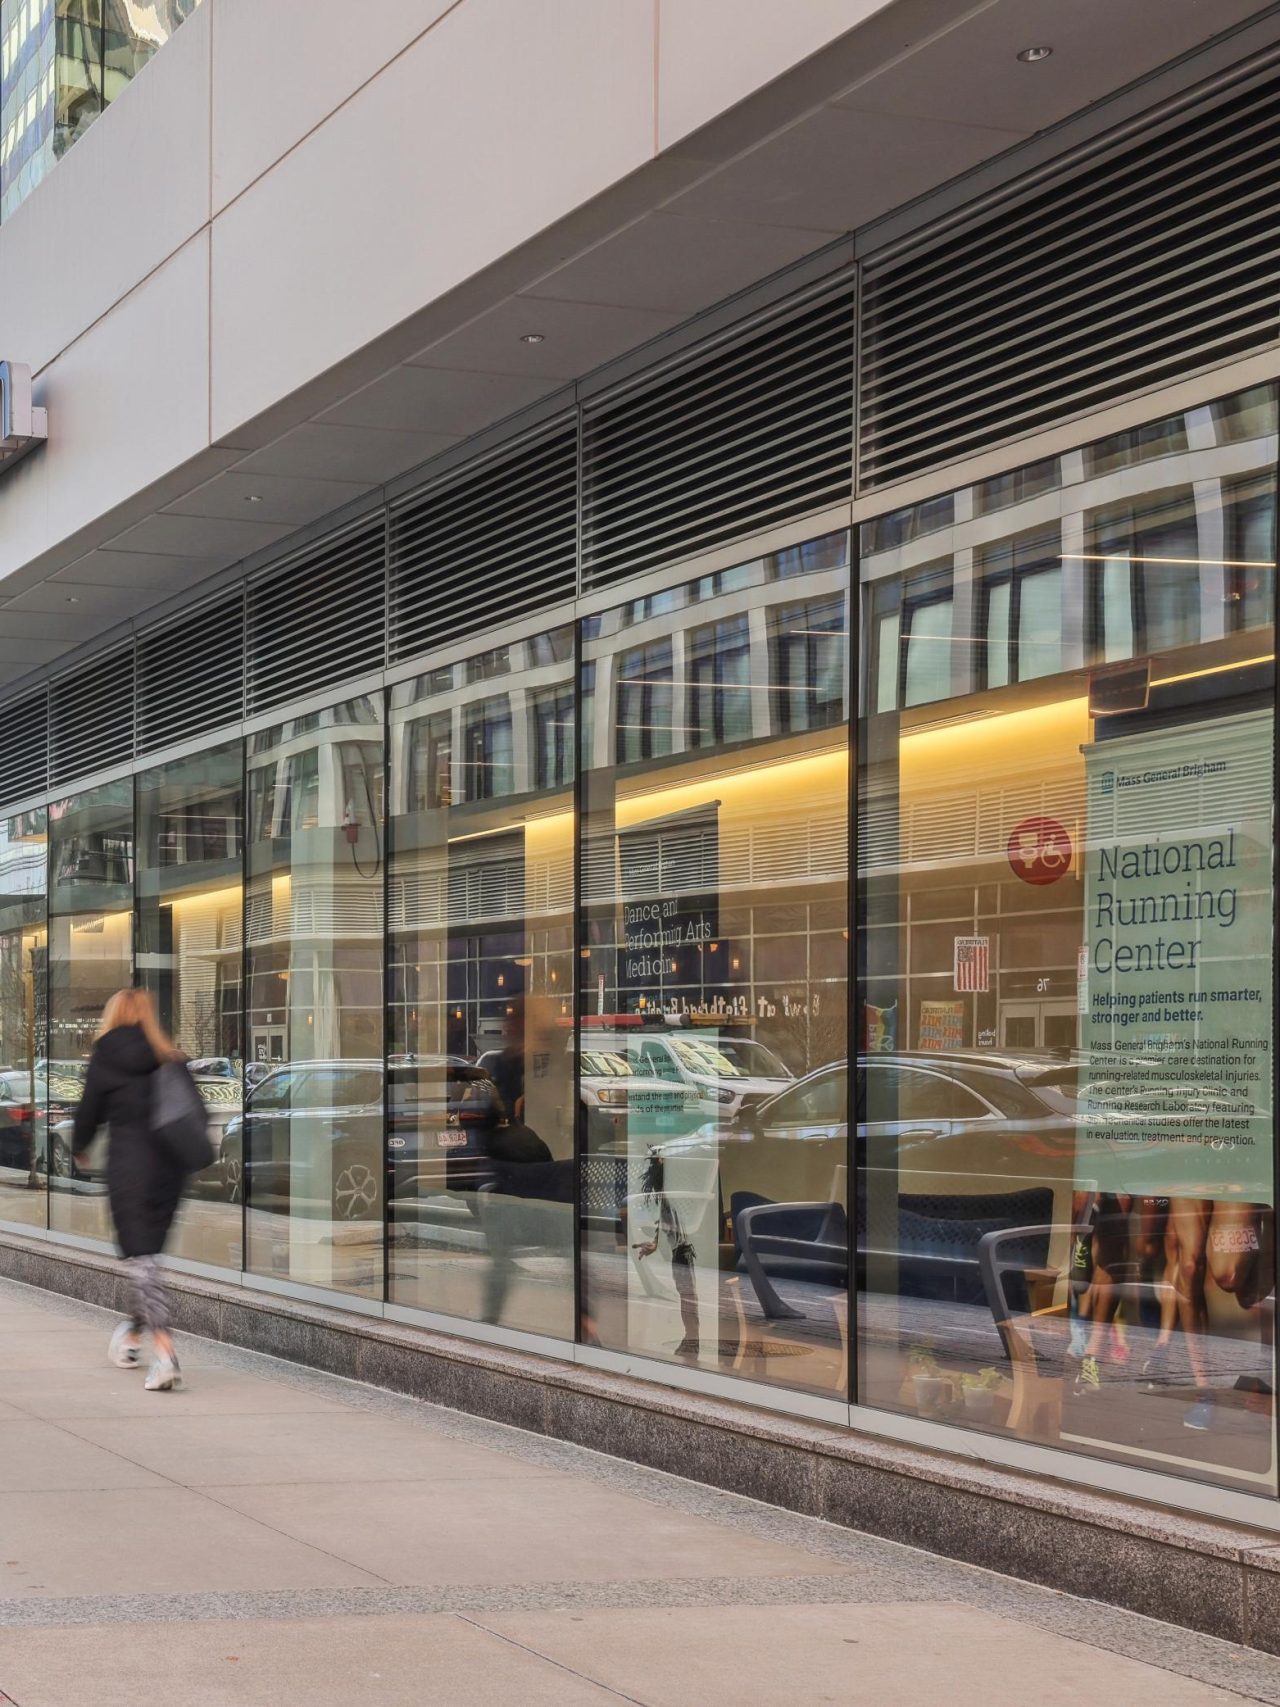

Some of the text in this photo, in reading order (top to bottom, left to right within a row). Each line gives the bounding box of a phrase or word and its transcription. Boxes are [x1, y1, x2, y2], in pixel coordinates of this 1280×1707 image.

[1116, 761, 1226, 787] Mass General Brigham
[1098, 828, 1236, 882] National
[1095, 882, 1236, 927] Running
[624, 904, 660, 925] Dance
[686, 920, 711, 940] Arts
[1094, 937, 1202, 973] Center
[626, 954, 677, 978] Medicin
[1092, 988, 1262, 1008] Helping patients run smarter,
[1091, 1008, 1203, 1026] stronger and better.
[1090, 1038, 1269, 1051] Mass General Brigham's National Running
[1089, 1055, 1117, 1065] Center
[1120, 1055, 1127, 1065] is
[1167, 1056, 1189, 1065] care
[1243, 1054, 1256, 1065] for
[1088, 1069, 1261, 1083] running-related musculoskeletal injuries.
[1089, 1086, 1103, 1095] The
[1105, 1085, 1138, 1095] center's
[1140, 1085, 1173, 1097] Running
[1230, 1086, 1248, 1097] and
[1087, 1100, 1255, 1115] Running Research Laboratory featuring
[1148, 1118, 1180, 1127] studies
[1183, 1117, 1204, 1127] offer
[1205, 1118, 1219, 1128] the
[1222, 1118, 1249, 1129] latest
[1086, 1129, 1093, 1139] in
[1141, 1130, 1185, 1142] treatment
[1187, 1133, 1202, 1143] and
[1204, 1134, 1256, 1146] prevention.
